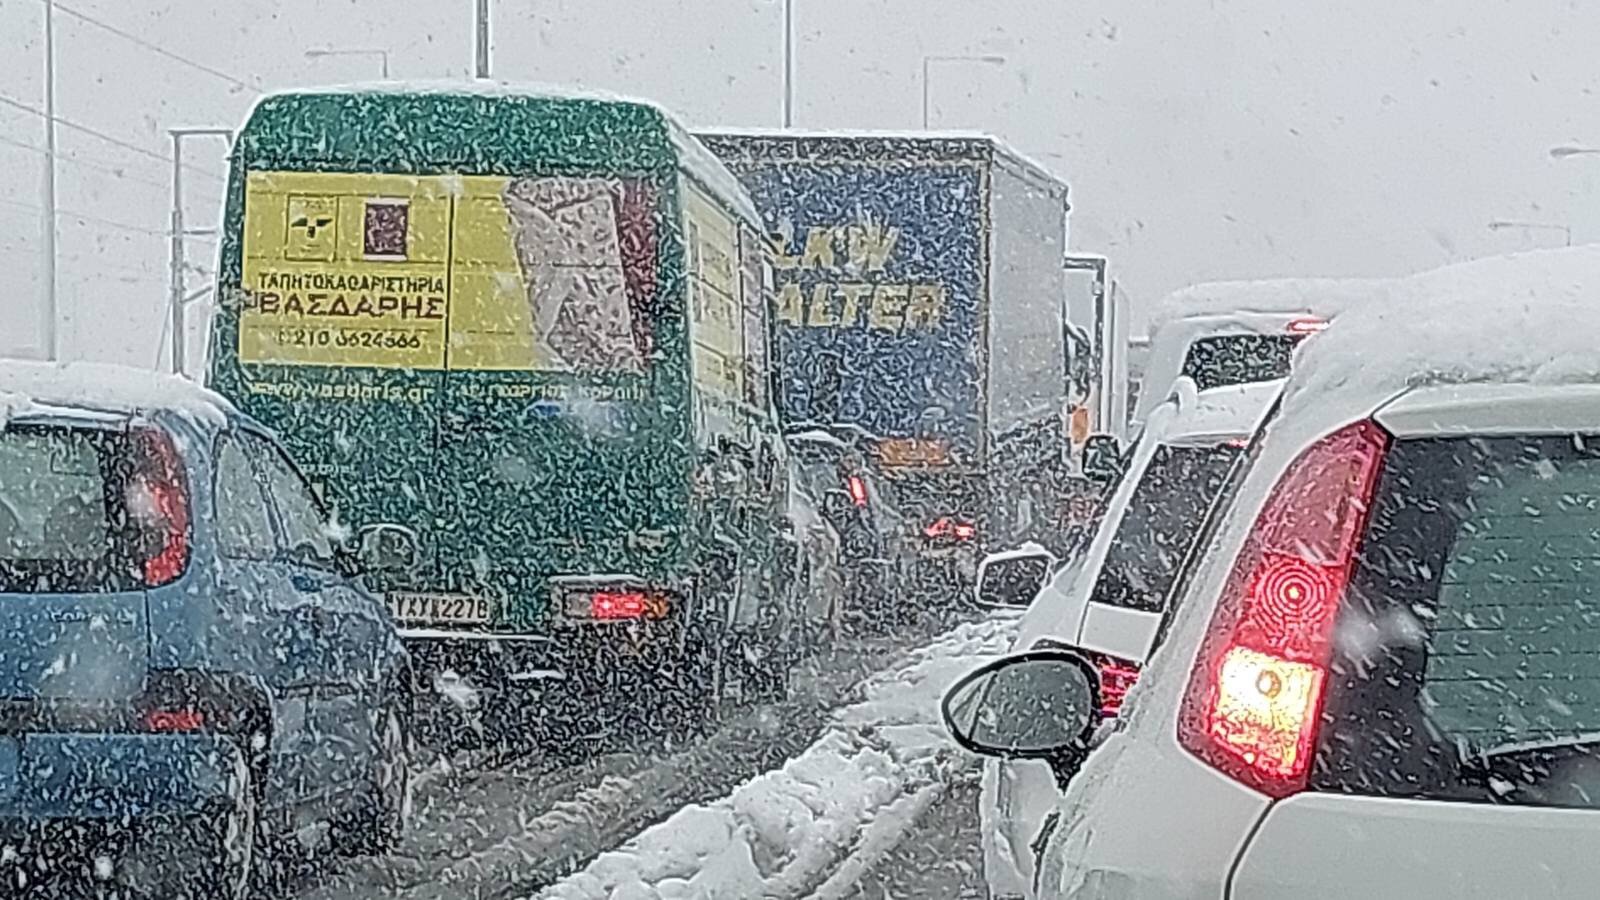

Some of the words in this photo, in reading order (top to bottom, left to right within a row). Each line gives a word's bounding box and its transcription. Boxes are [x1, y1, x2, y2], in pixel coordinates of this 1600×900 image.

[259, 293, 445, 319] ΒΑΣΔΑΡΗΣ
[776, 283, 947, 331] ALTER
[294, 329, 330, 347] 210
